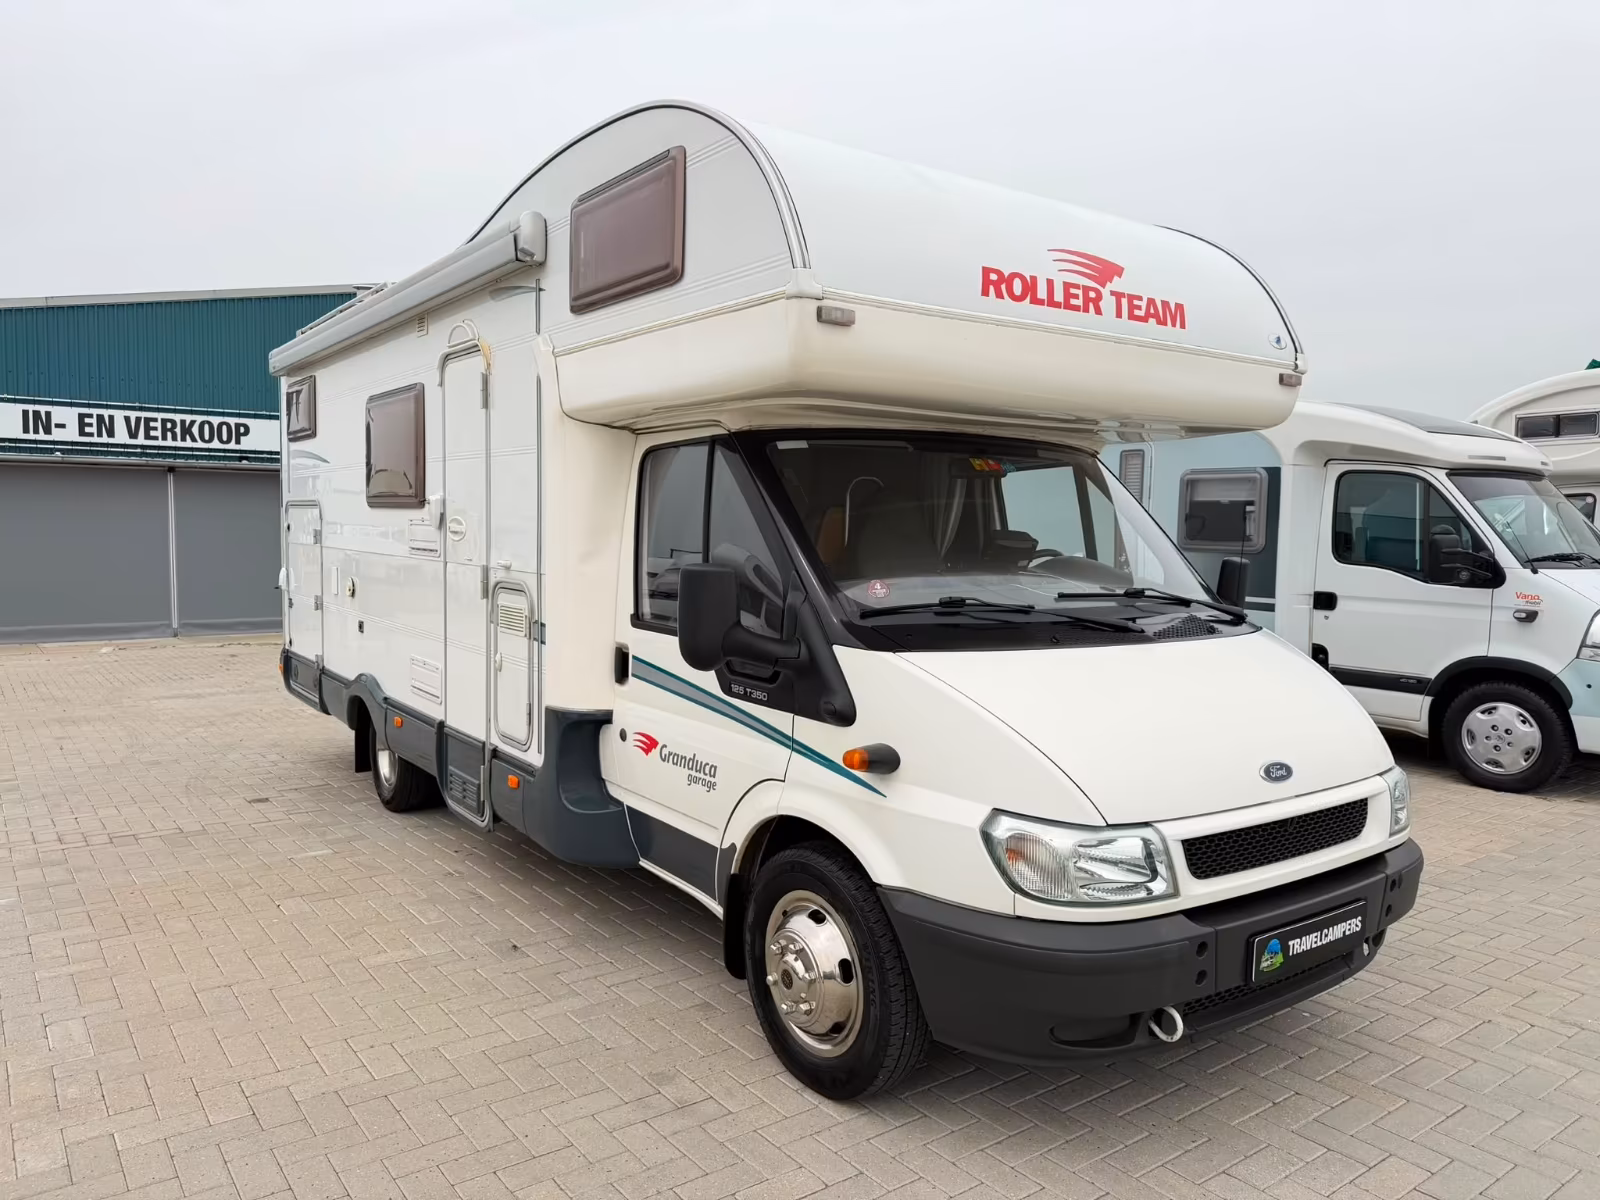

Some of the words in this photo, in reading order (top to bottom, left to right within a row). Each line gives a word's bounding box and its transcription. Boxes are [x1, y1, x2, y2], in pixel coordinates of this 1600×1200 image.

[981, 265, 1103, 316] ROLLER
[1109, 289, 1186, 329] TEAM
[21, 409, 67, 436] IN-
[77, 412, 116, 439] EN
[123, 415, 251, 445] VERKOOP
[730, 683, 745, 695] 125
[745, 687, 768, 701] T350
[659, 743, 718, 779] Granduca
[1269, 765, 1288, 778] Ford
[687, 772, 717, 793] garage
[1288, 915, 1362, 957] TRAVELCAMPERS
